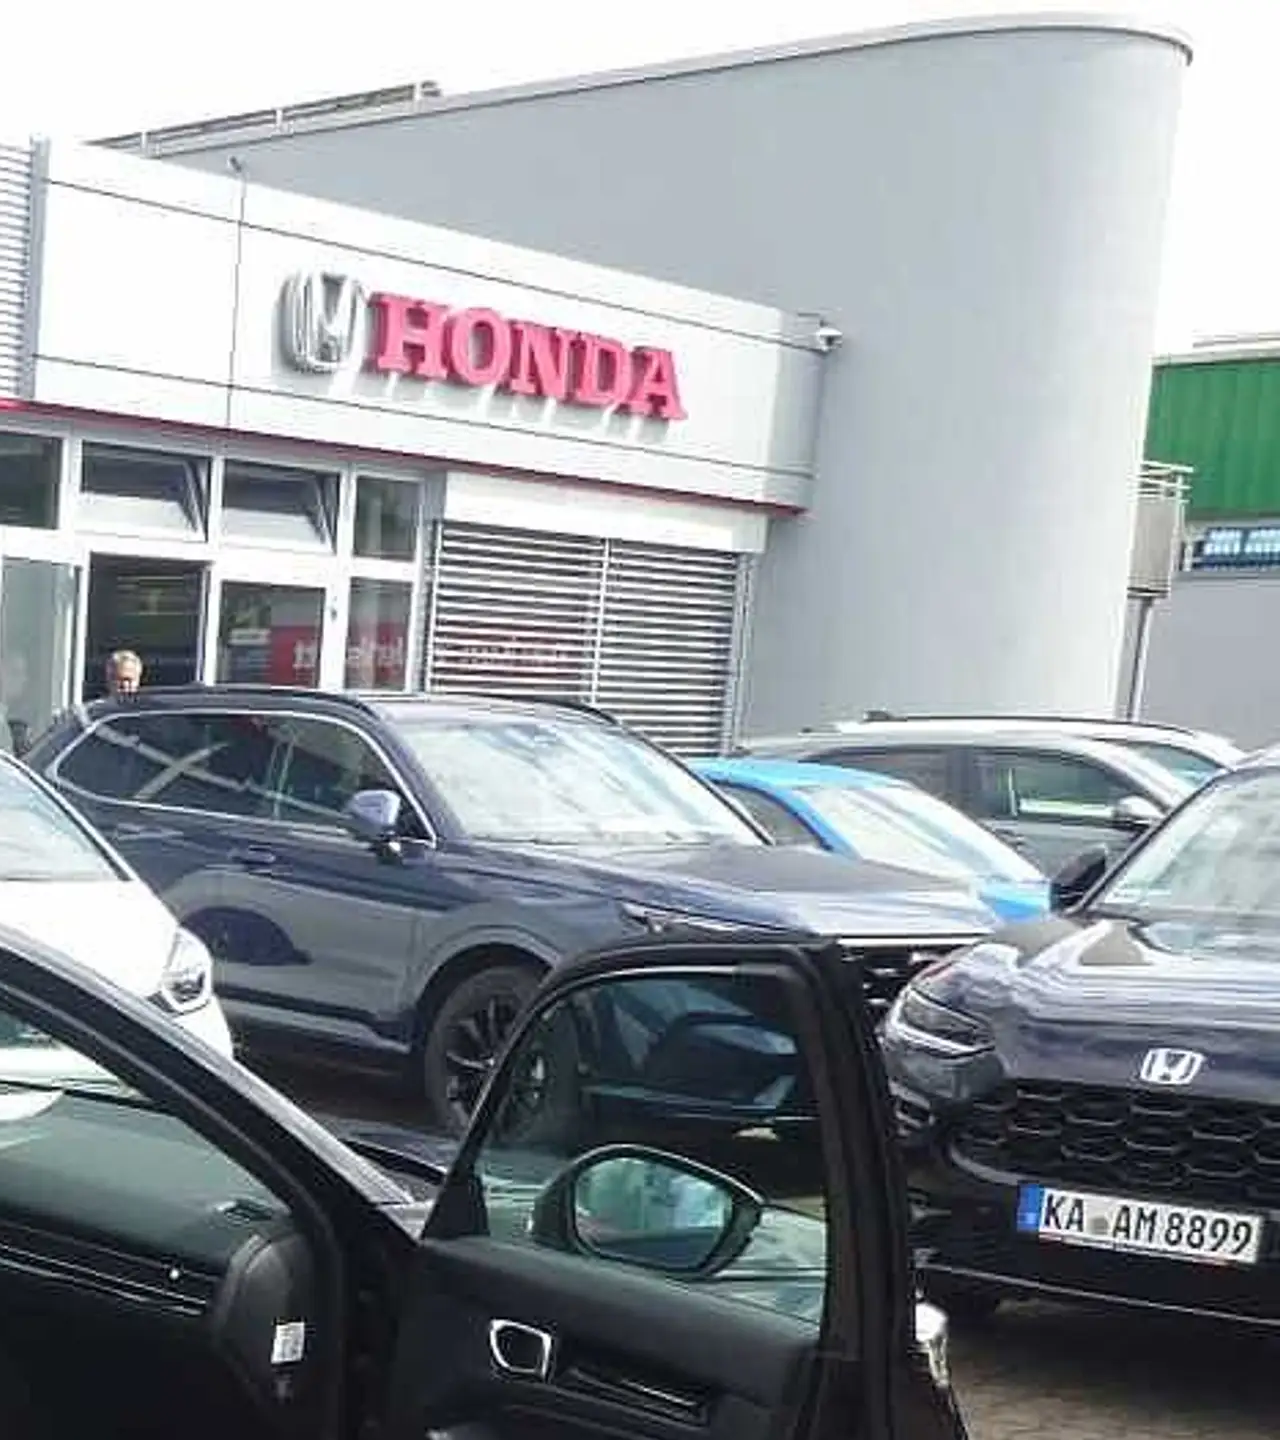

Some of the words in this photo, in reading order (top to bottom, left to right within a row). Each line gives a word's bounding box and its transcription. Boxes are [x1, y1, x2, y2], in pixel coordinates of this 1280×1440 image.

[371, 291, 687, 421] HONDA
[1043, 1193, 1085, 1233] KA
[1163, 1211, 1254, 1255] 8899
